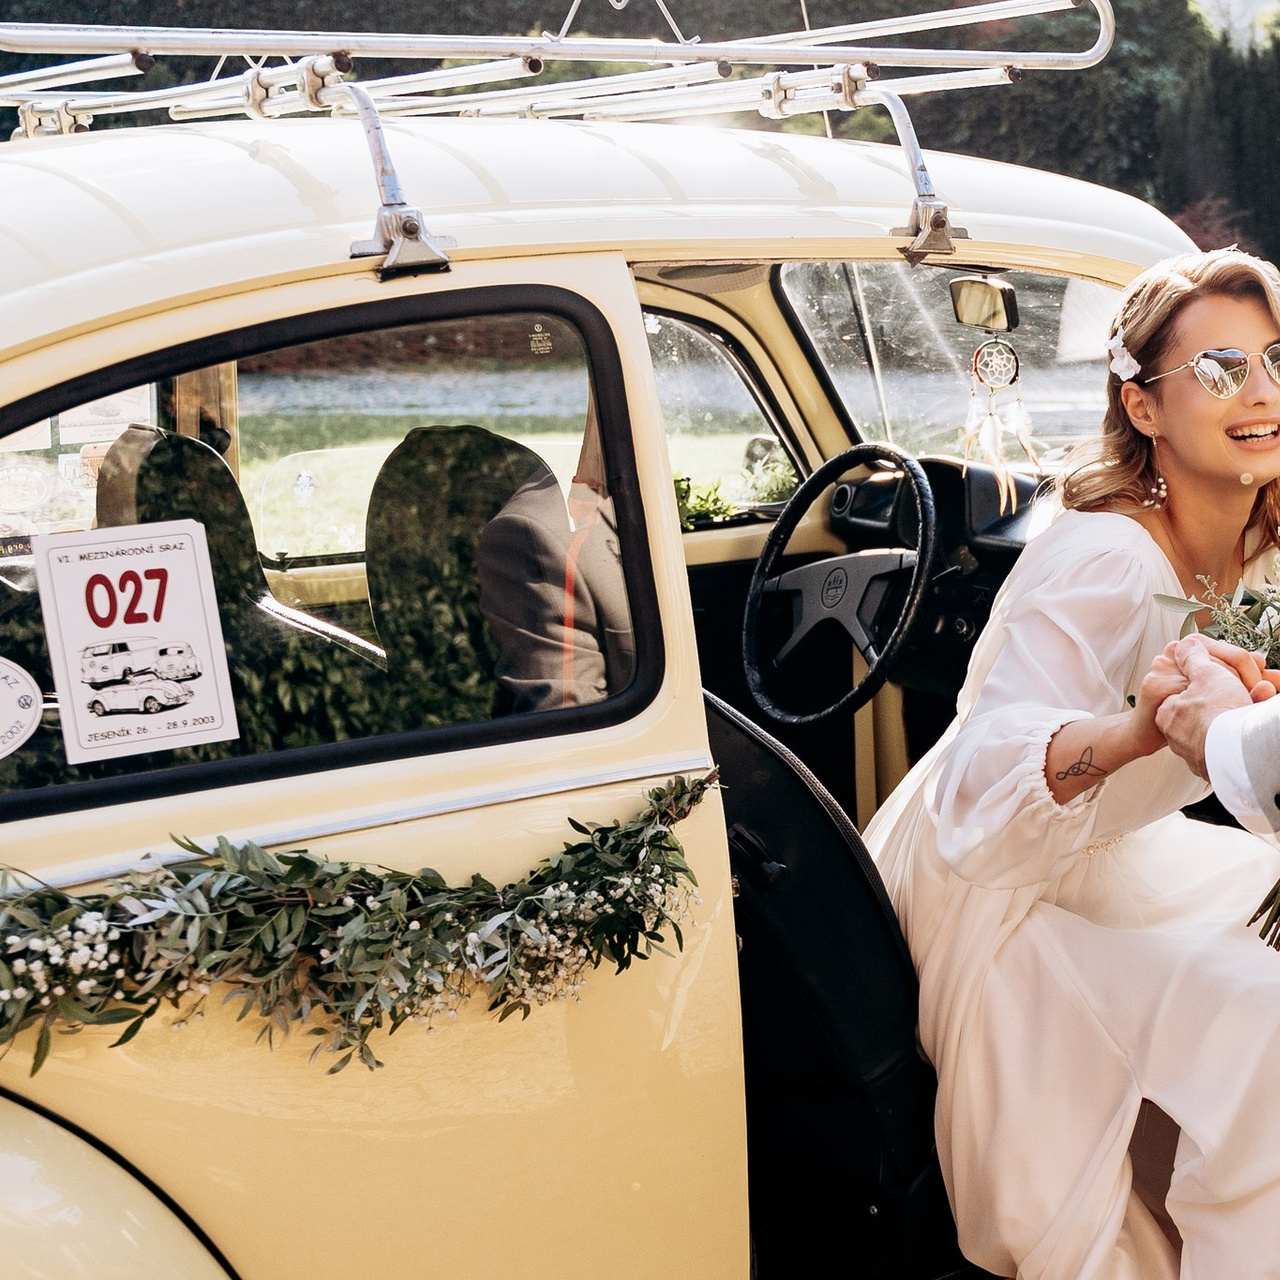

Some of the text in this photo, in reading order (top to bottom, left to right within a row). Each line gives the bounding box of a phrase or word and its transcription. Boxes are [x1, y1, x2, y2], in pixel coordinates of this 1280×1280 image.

[79, 543, 155, 561] MEZINÁRODNÍ
[159, 542, 186, 553] SRAZ
[85, 568, 168, 629] 027
[87, 726, 133, 743] JESENÍK
[136, 725, 152, 735] 26.
